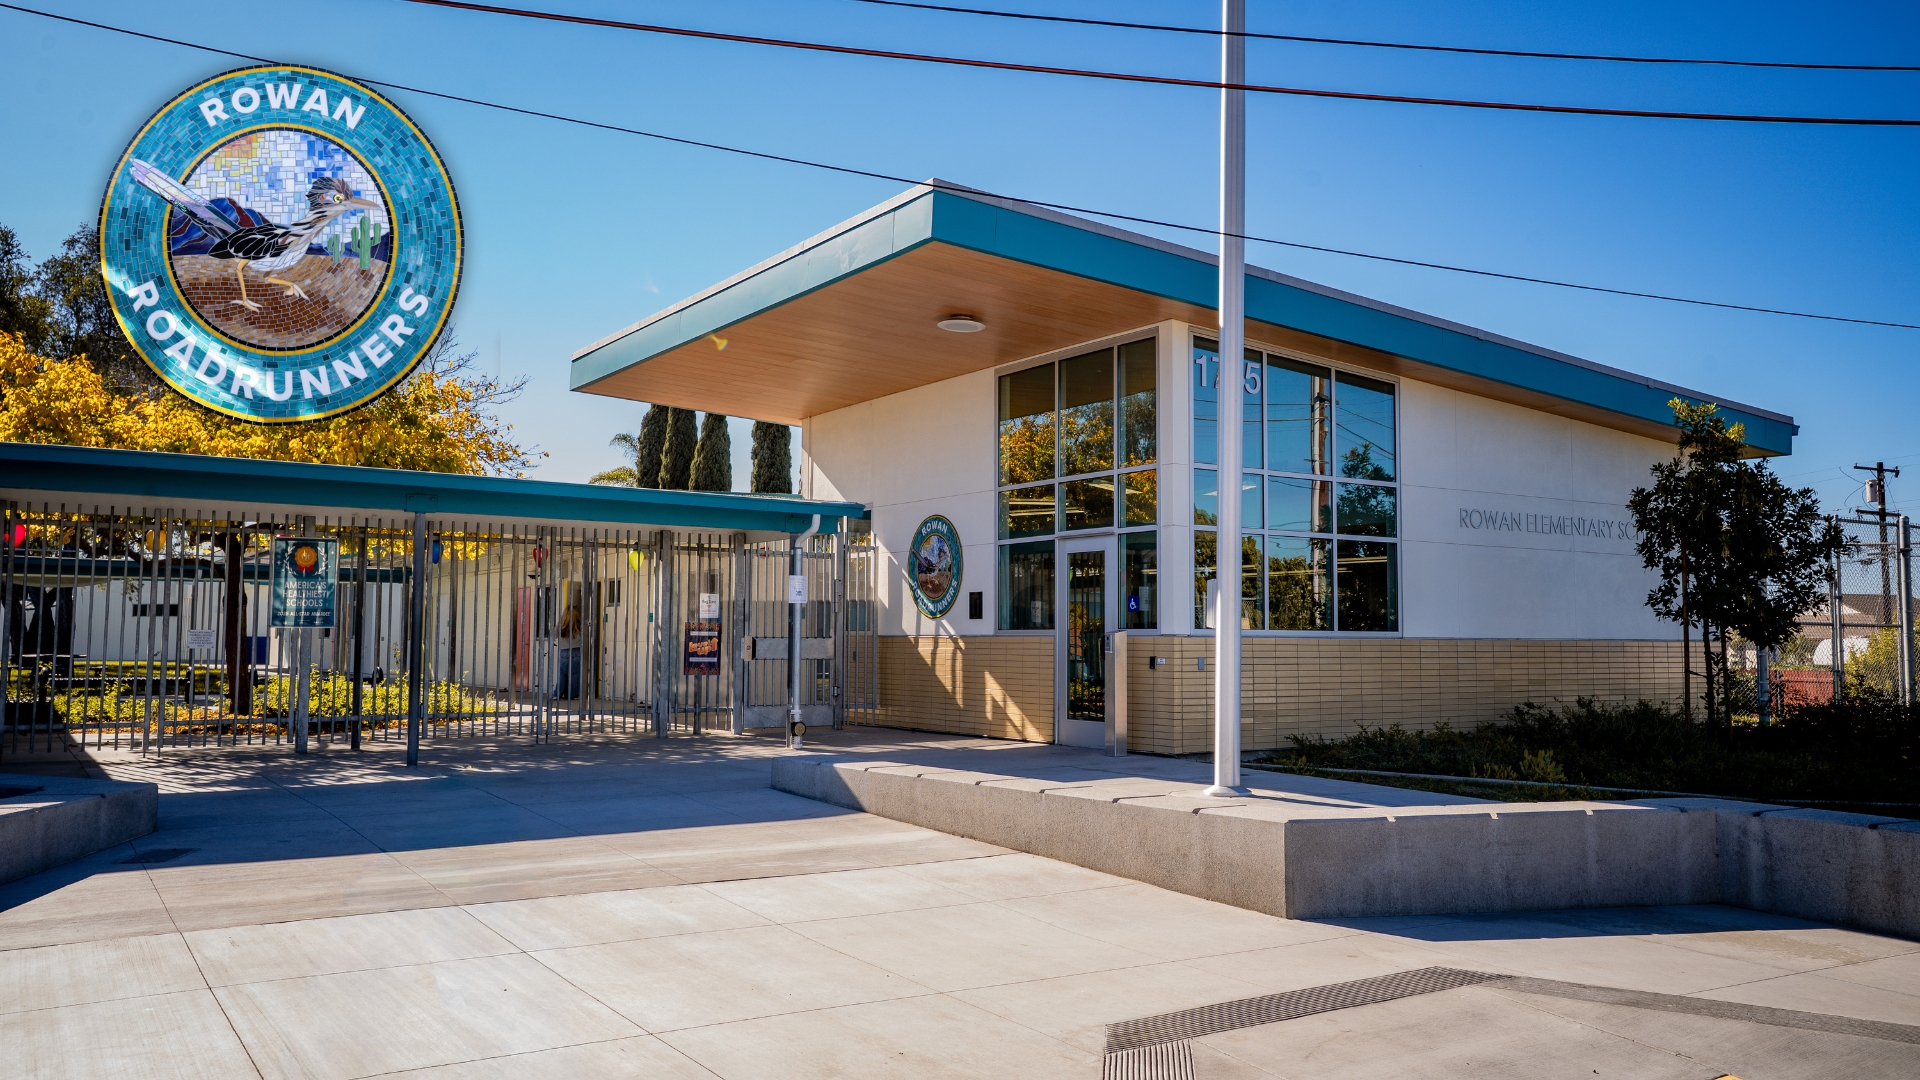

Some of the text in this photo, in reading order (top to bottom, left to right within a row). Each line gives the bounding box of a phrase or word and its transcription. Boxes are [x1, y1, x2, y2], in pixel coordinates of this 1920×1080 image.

[921, 520, 948, 536] ROWAN
[1459, 507, 1522, 532] ROWAN
[1526, 513, 1614, 539] ELEMENTARY
[284, 581, 327, 589] AMERICA'S
[282, 589, 327, 598] HEALTHIEST
[912, 579, 958, 613] ROADRUNNERS
[286, 599, 324, 607] SCHOOLS
